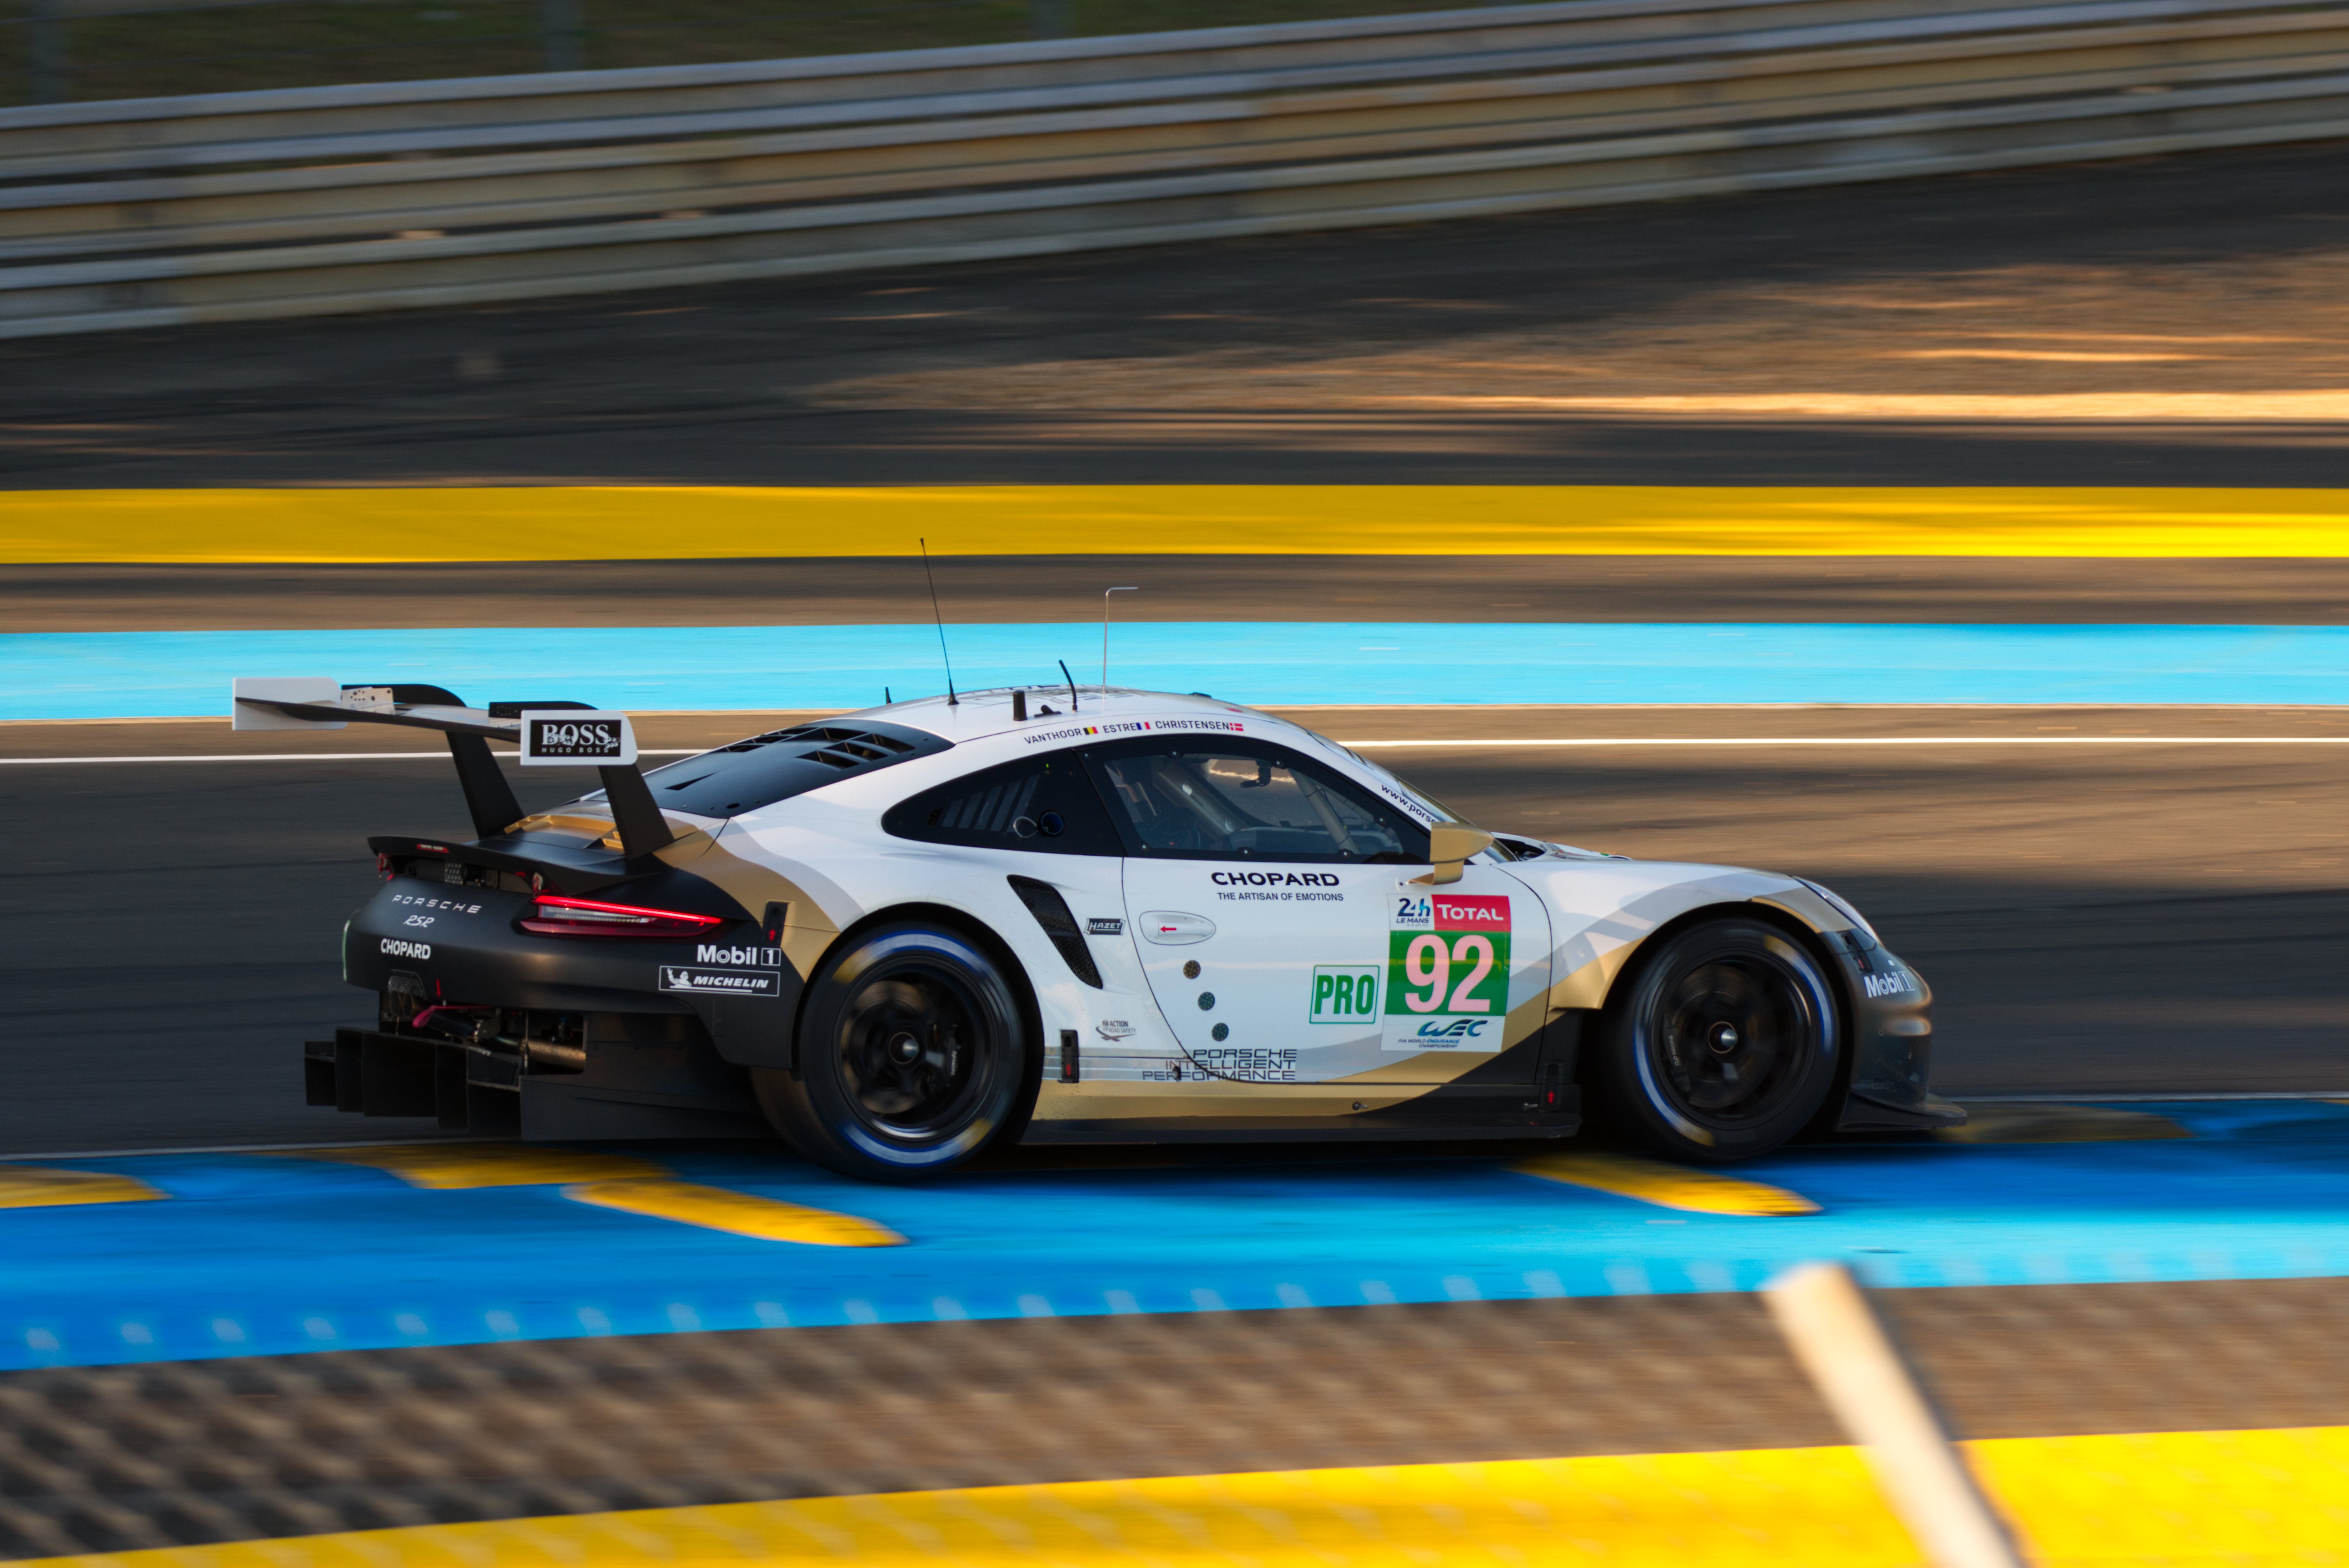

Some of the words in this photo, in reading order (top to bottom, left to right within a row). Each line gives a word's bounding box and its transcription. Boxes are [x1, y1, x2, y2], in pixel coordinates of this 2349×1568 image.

[542, 724, 609, 746] BOSS
[1024, 728, 1082, 744] VANTHOOR
[1103, 723, 1137, 733] ESTRE
[1155, 720, 1230, 730] CHRISTENSEN
[1211, 872, 1340, 886] CHOPARD
[392, 894, 482, 914] PORSCHE
[1397, 898, 1431, 917] 24h
[1436, 904, 1504, 921] TOTAL
[403, 915, 435, 928] RSR
[1089, 922, 1122, 931] HAZET
[380, 938, 431, 960] CHOPARD
[697, 944, 757, 965] Mobil
[693, 976, 769, 988] MICHELIN
[1405, 934, 1494, 1013] 92
[1864, 971, 1905, 998] Mobil
[1314, 975, 1375, 1015] PRO
[1417, 1019, 1488, 1037] WEC
[1193, 1049, 1297, 1059] PORSCHE
[1166, 1059, 1296, 1070] INTELLIGENT
[1142, 1070, 1296, 1081] PERFORMANCE
